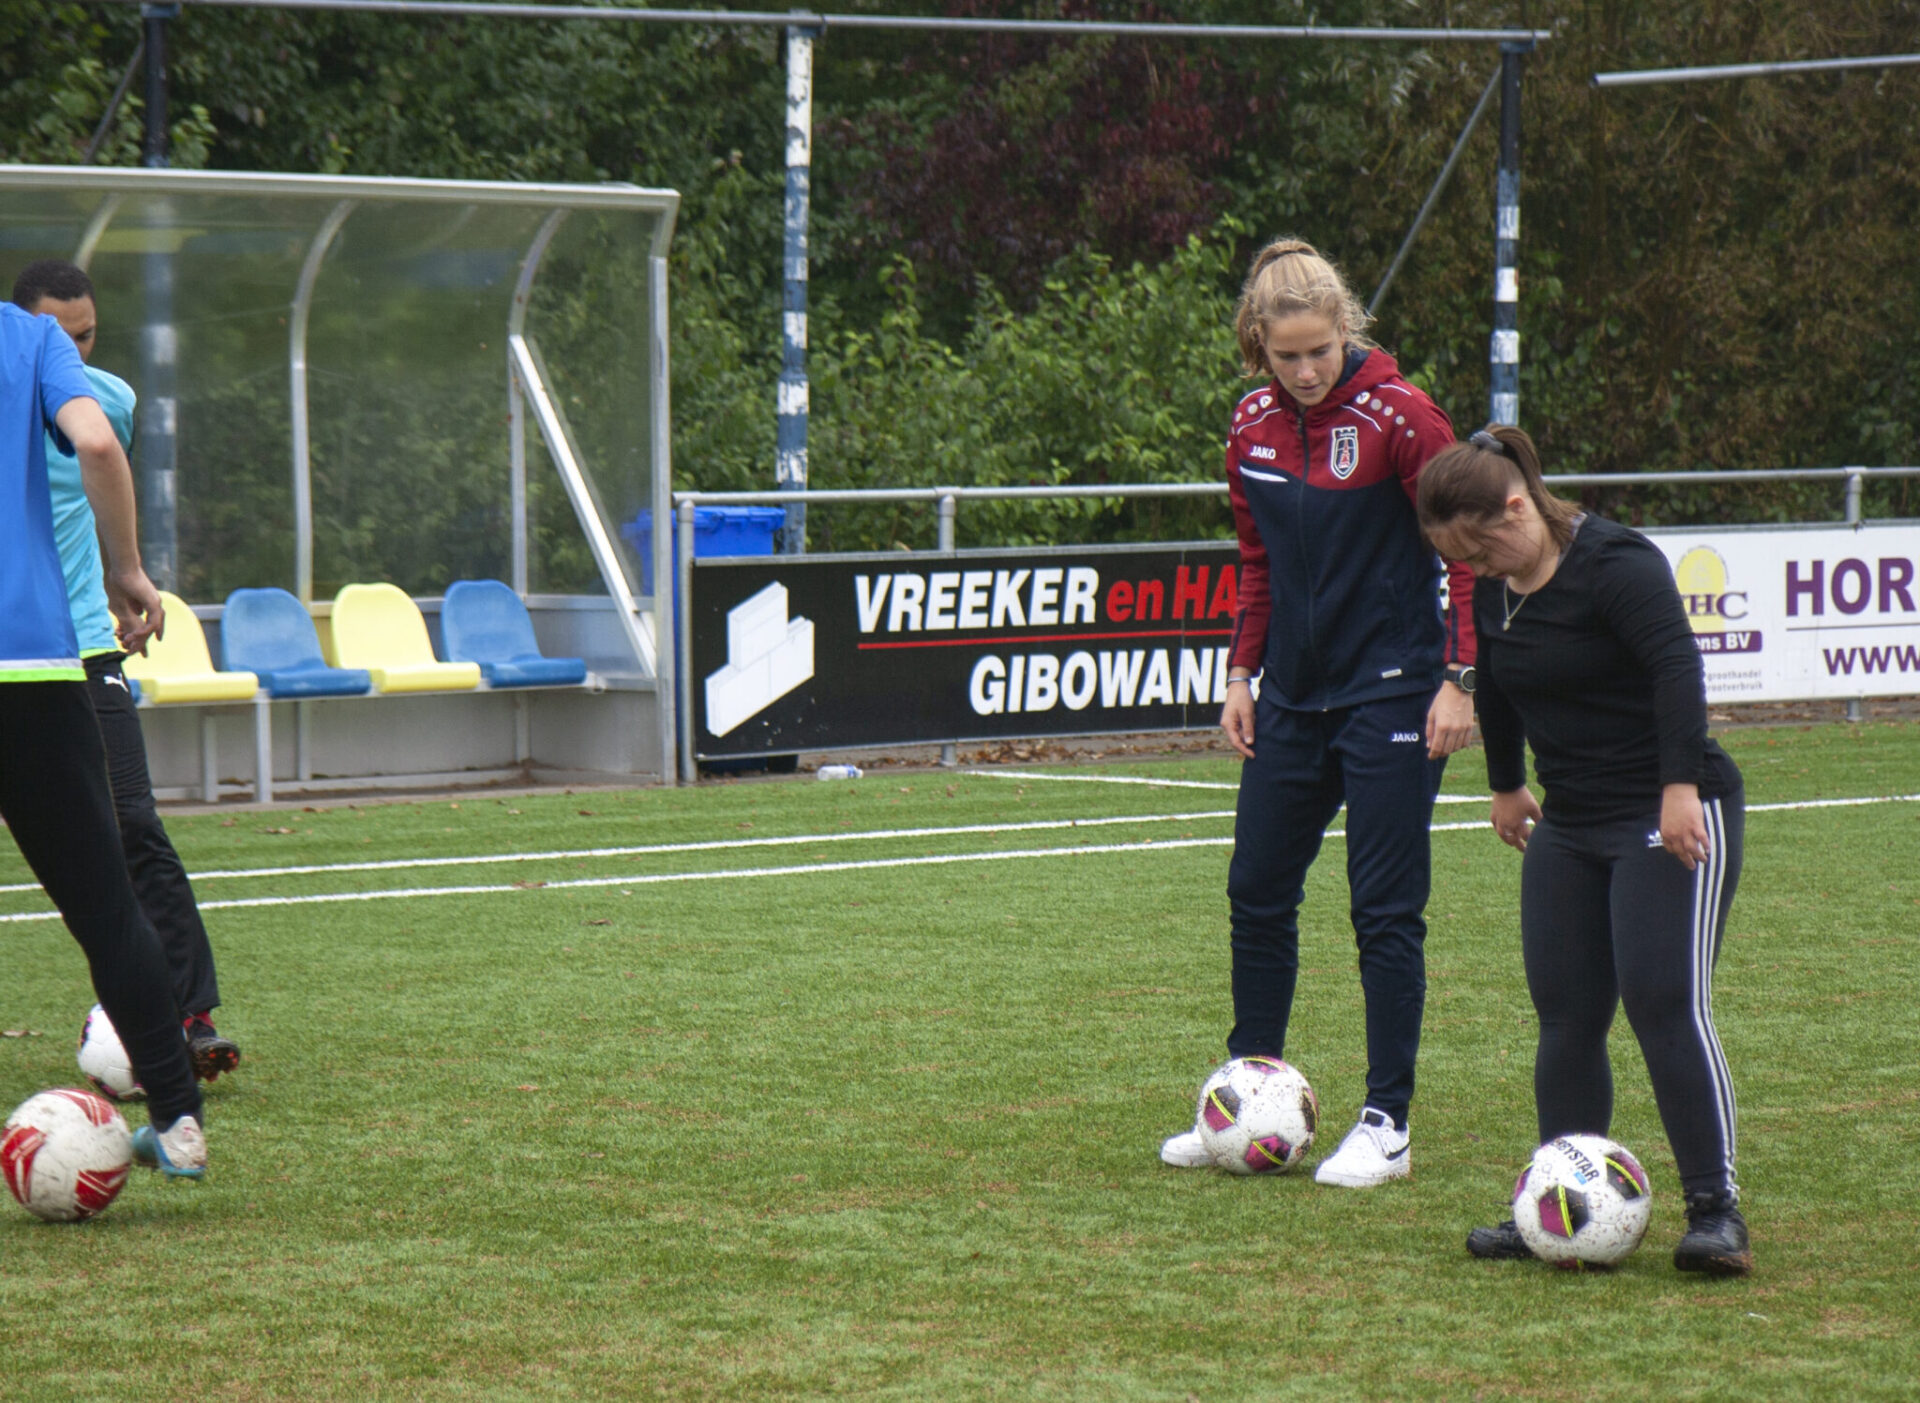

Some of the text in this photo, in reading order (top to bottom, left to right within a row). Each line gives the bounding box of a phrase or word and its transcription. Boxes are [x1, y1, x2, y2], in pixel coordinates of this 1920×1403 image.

[1250, 445, 1277, 460] JAKO
[855, 564, 1237, 633] VREEKER en HA
[1786, 557, 1917, 617] HOR
[1682, 591, 1749, 619] HC
[1726, 632, 1752, 650] BV
[1822, 645, 1920, 676] www
[1706, 681, 1763, 692] rootverbruik
[1391, 732, 1420, 743] JAKO
